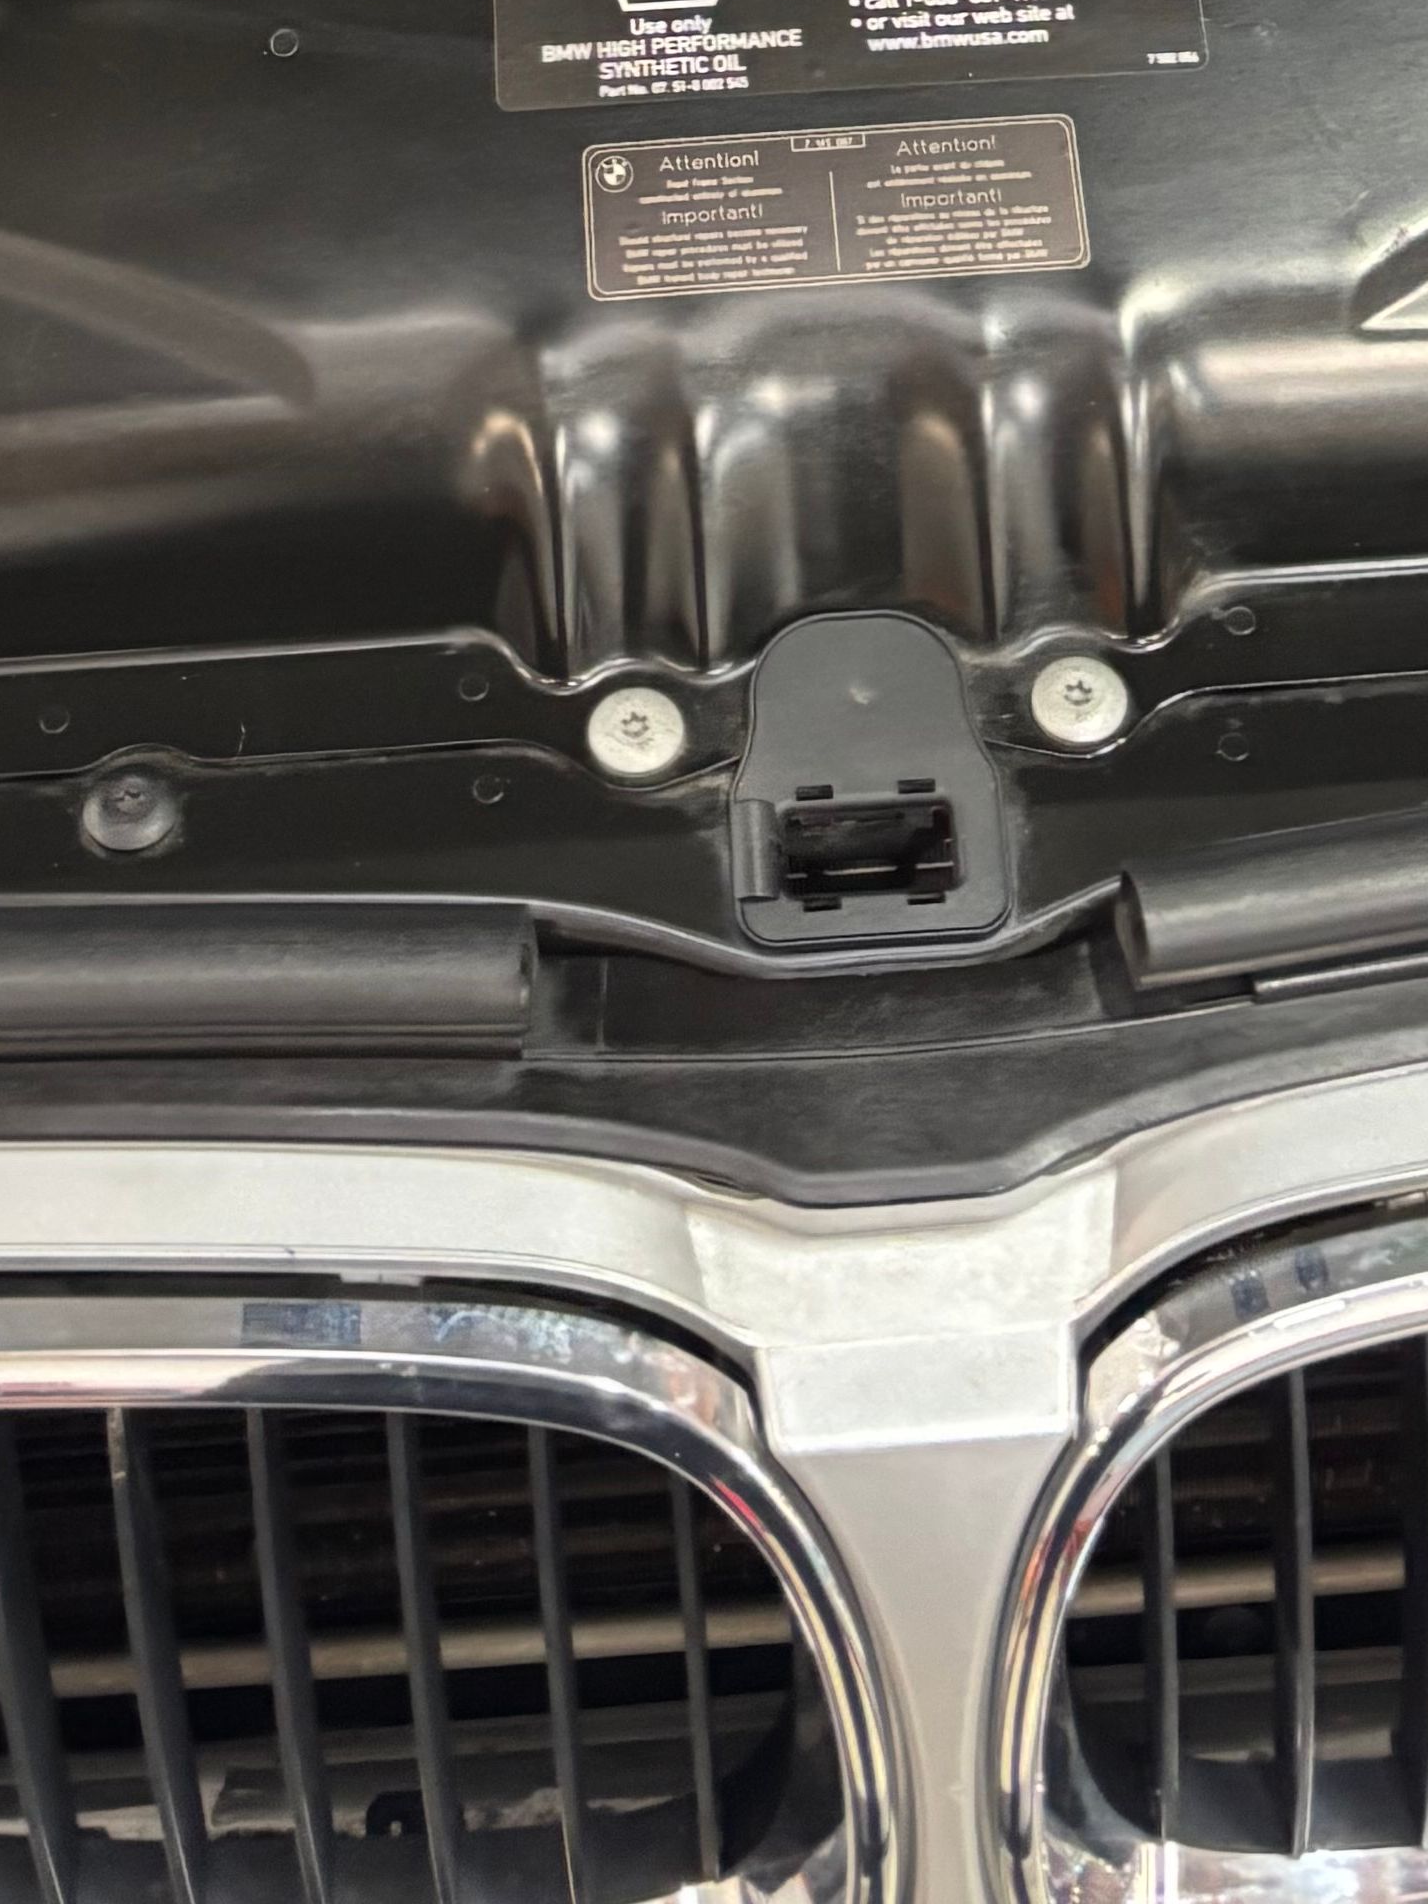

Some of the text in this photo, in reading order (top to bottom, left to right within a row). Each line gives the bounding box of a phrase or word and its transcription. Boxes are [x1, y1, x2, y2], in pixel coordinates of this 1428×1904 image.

[630, 15, 712, 35] Use only
[866, 4, 1075, 30] or visit our web site at
[541, 29, 802, 63] BMW HIGH PERFORMANCE
[868, 29, 1049, 52] www.bmwusa.com
[599, 54, 746, 80] SYNTHETIC OIL
[897, 135, 996, 156] Attention!
[660, 150, 759, 172] Attention!
[901, 188, 1002, 208] Important!
[662, 203, 762, 227] Important!
